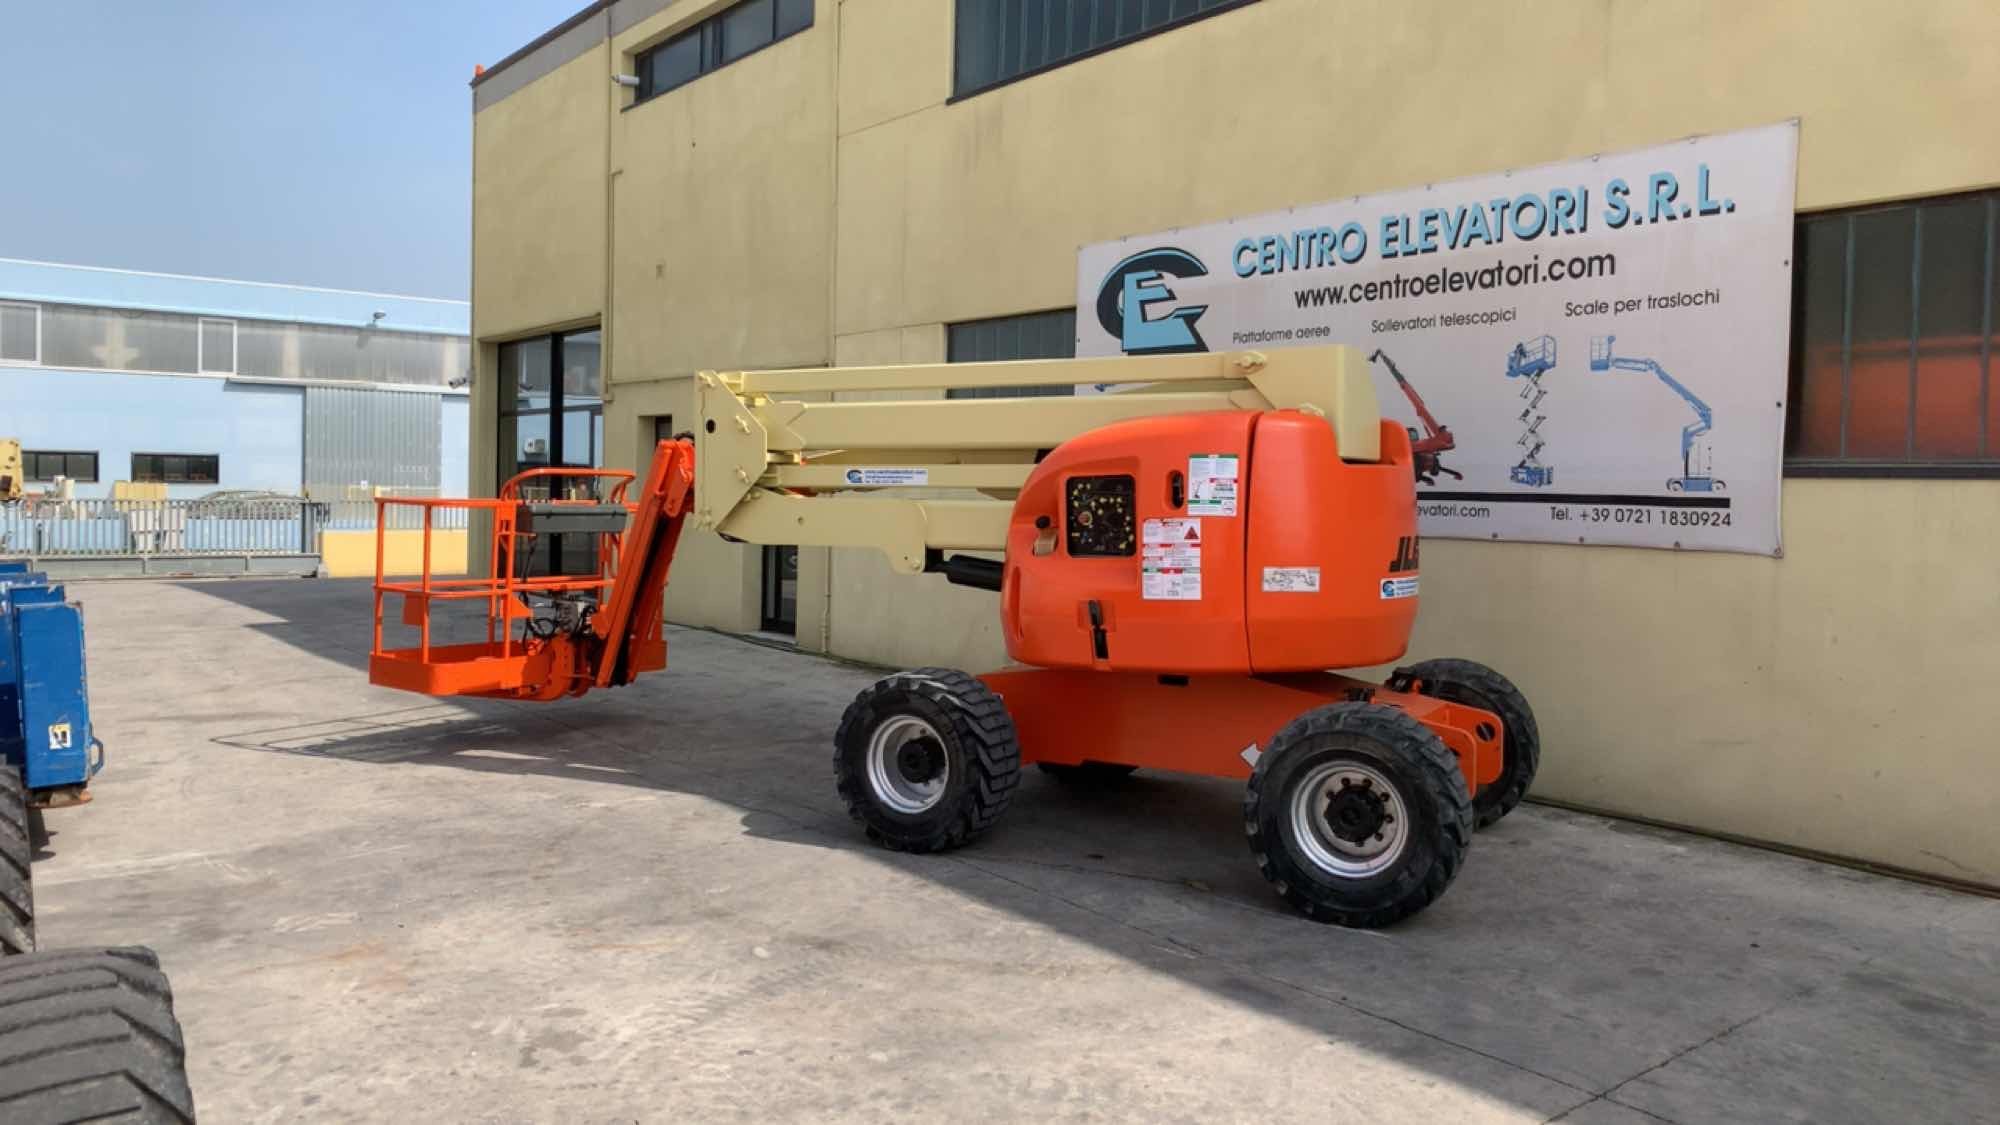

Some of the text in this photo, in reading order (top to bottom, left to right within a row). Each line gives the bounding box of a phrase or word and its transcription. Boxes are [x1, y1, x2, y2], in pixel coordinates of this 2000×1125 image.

[1232, 163, 1736, 279] CENTRO ELEVATORI S.R.L.
[1294, 252, 1616, 309] www.centroelevatori.com
[1564, 288, 1721, 317] Scale per traslochi
[1232, 325, 1330, 344] Piattaforme aeree
[1371, 307, 1517, 334] Sollevatori telescopici
[1550, 506, 1731, 527] Tel. +39 0721 1830924
